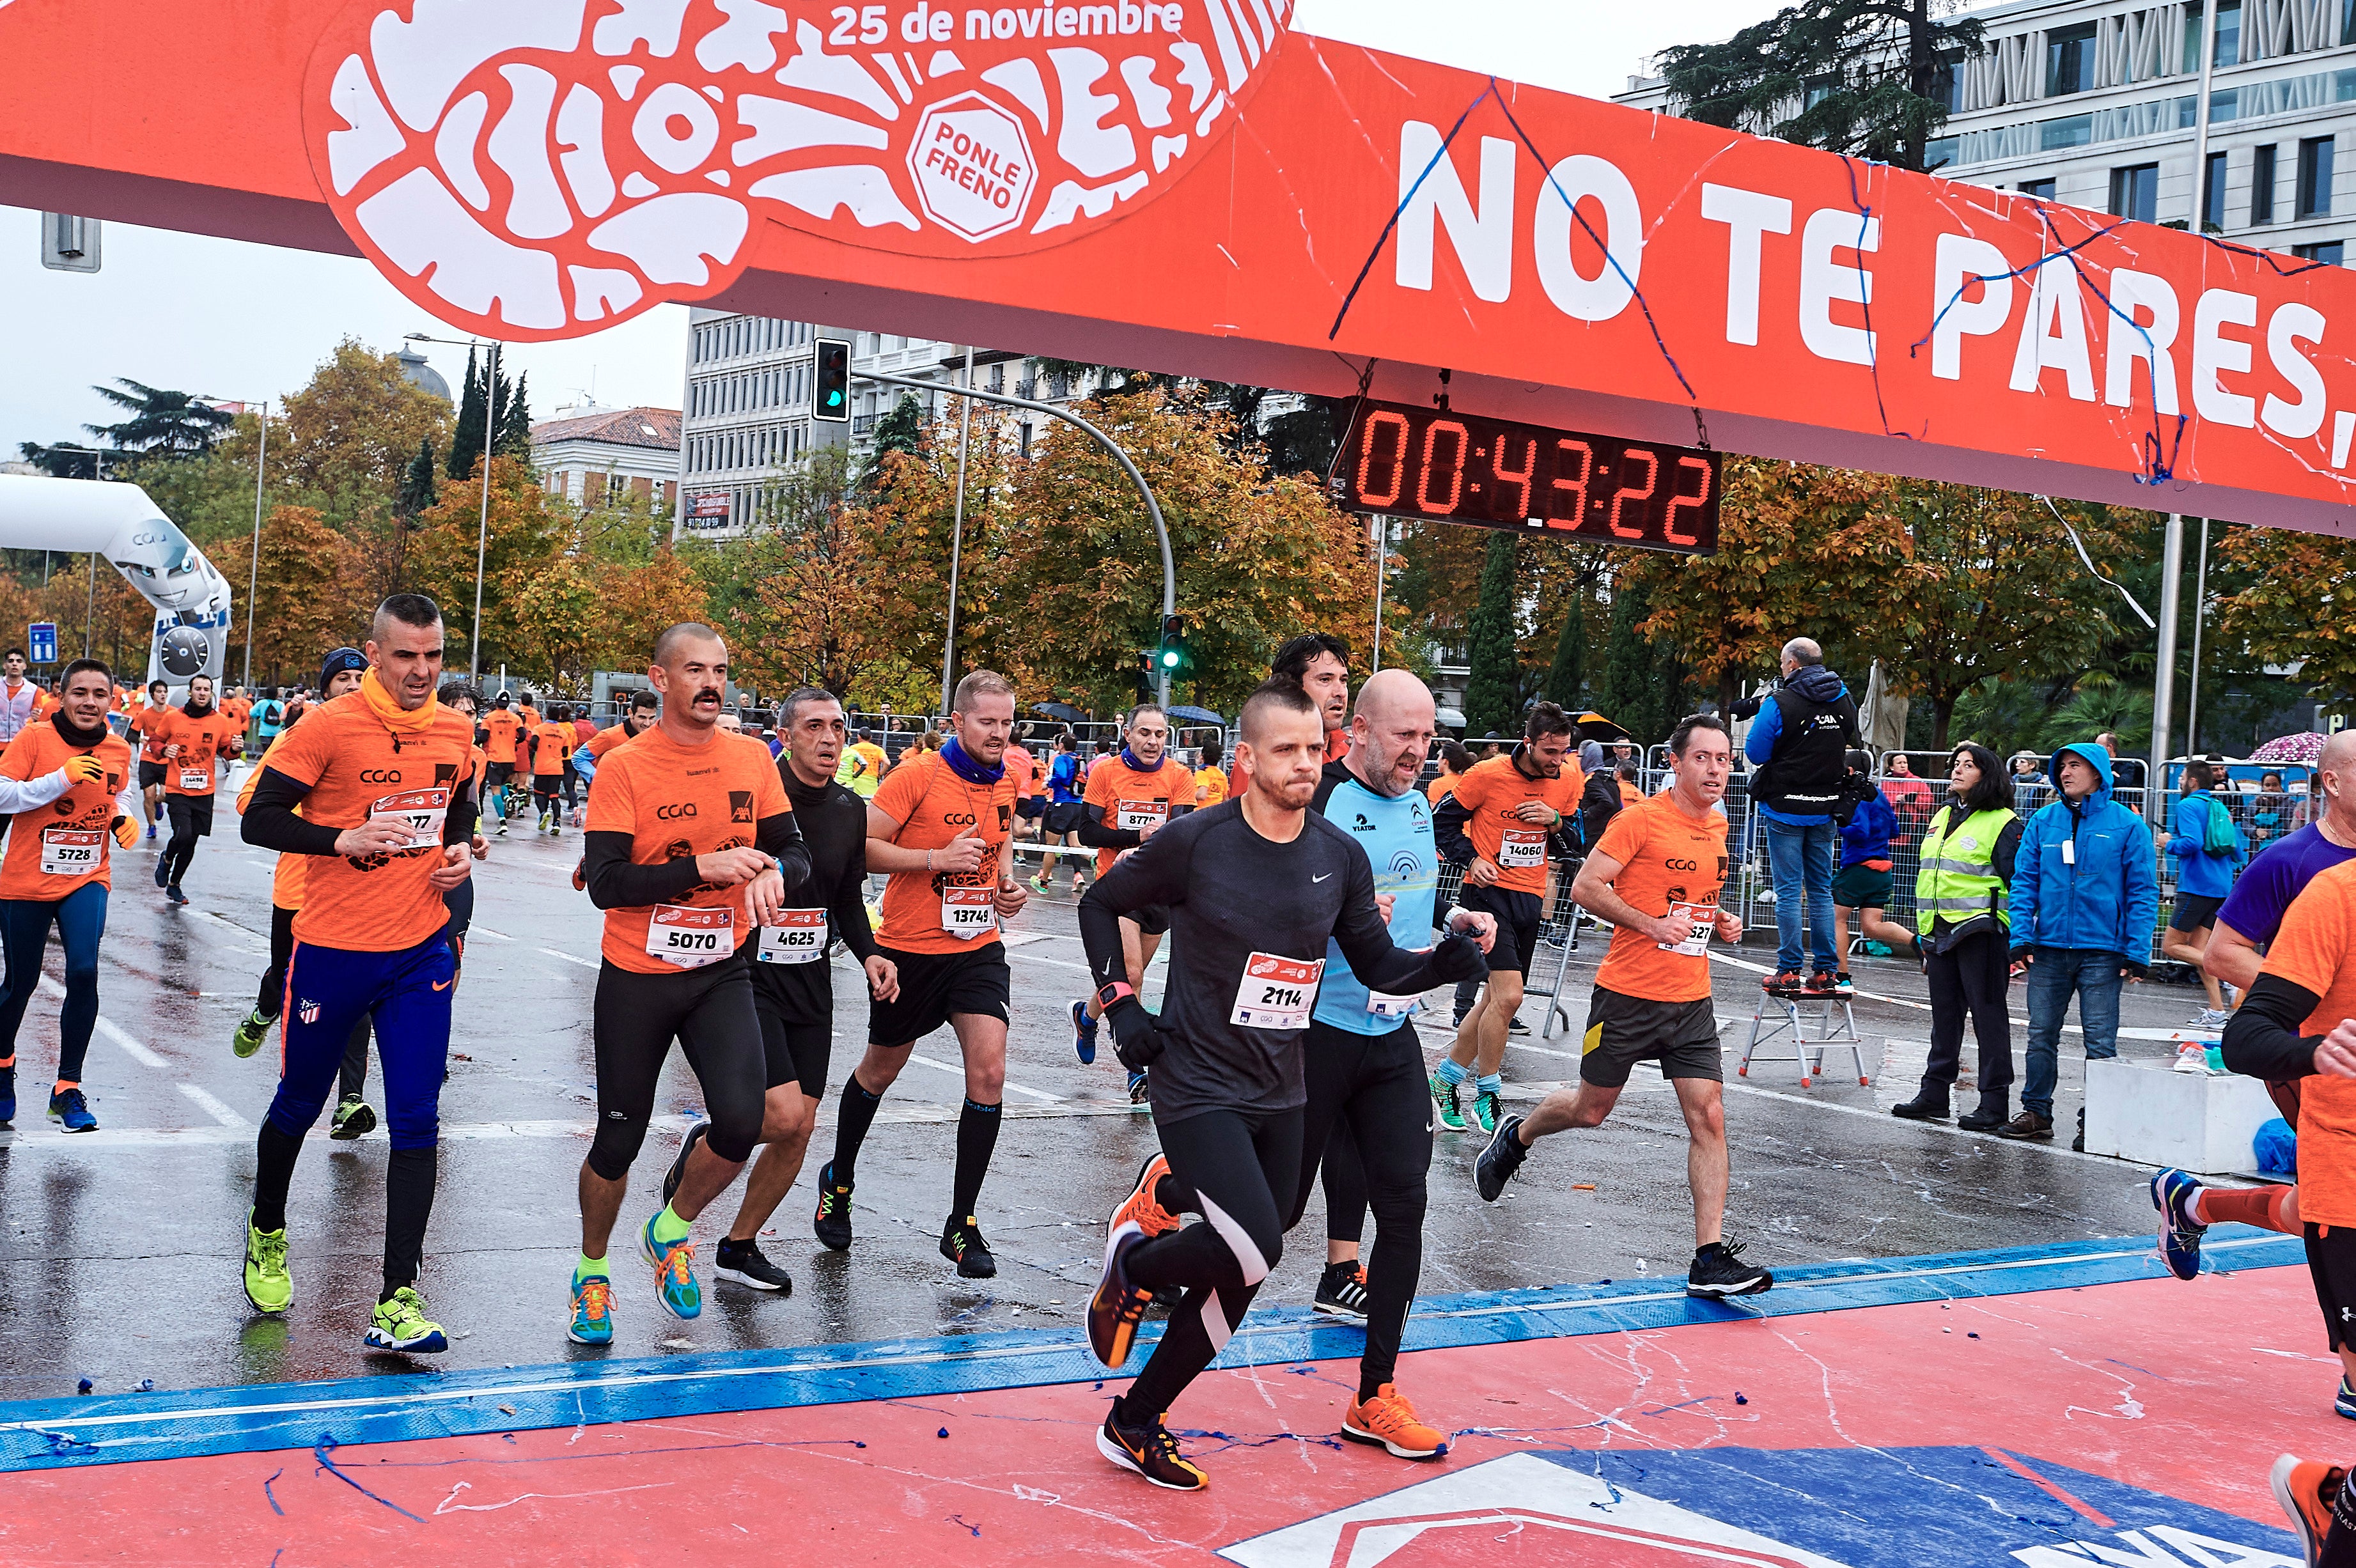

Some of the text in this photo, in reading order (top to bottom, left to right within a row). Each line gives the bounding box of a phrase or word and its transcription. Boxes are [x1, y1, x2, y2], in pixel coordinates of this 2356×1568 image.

[829, 0, 1183, 45] 25 de noviembre
[935, 121, 1021, 187] PONLE
[925, 148, 1011, 209] FRENO
[1395, 119, 1644, 322] NO
[1701, 182, 1879, 367] TE
[1356, 410, 1712, 546] 00:43:22
[58, 849, 91, 860] 5728
[1510, 846, 1541, 855] 14060
[953, 910, 988, 922] 13749
[667, 932, 716, 949] 5070
[777, 932, 815, 945] 4625
[1261, 986, 1302, 1006] 2114
